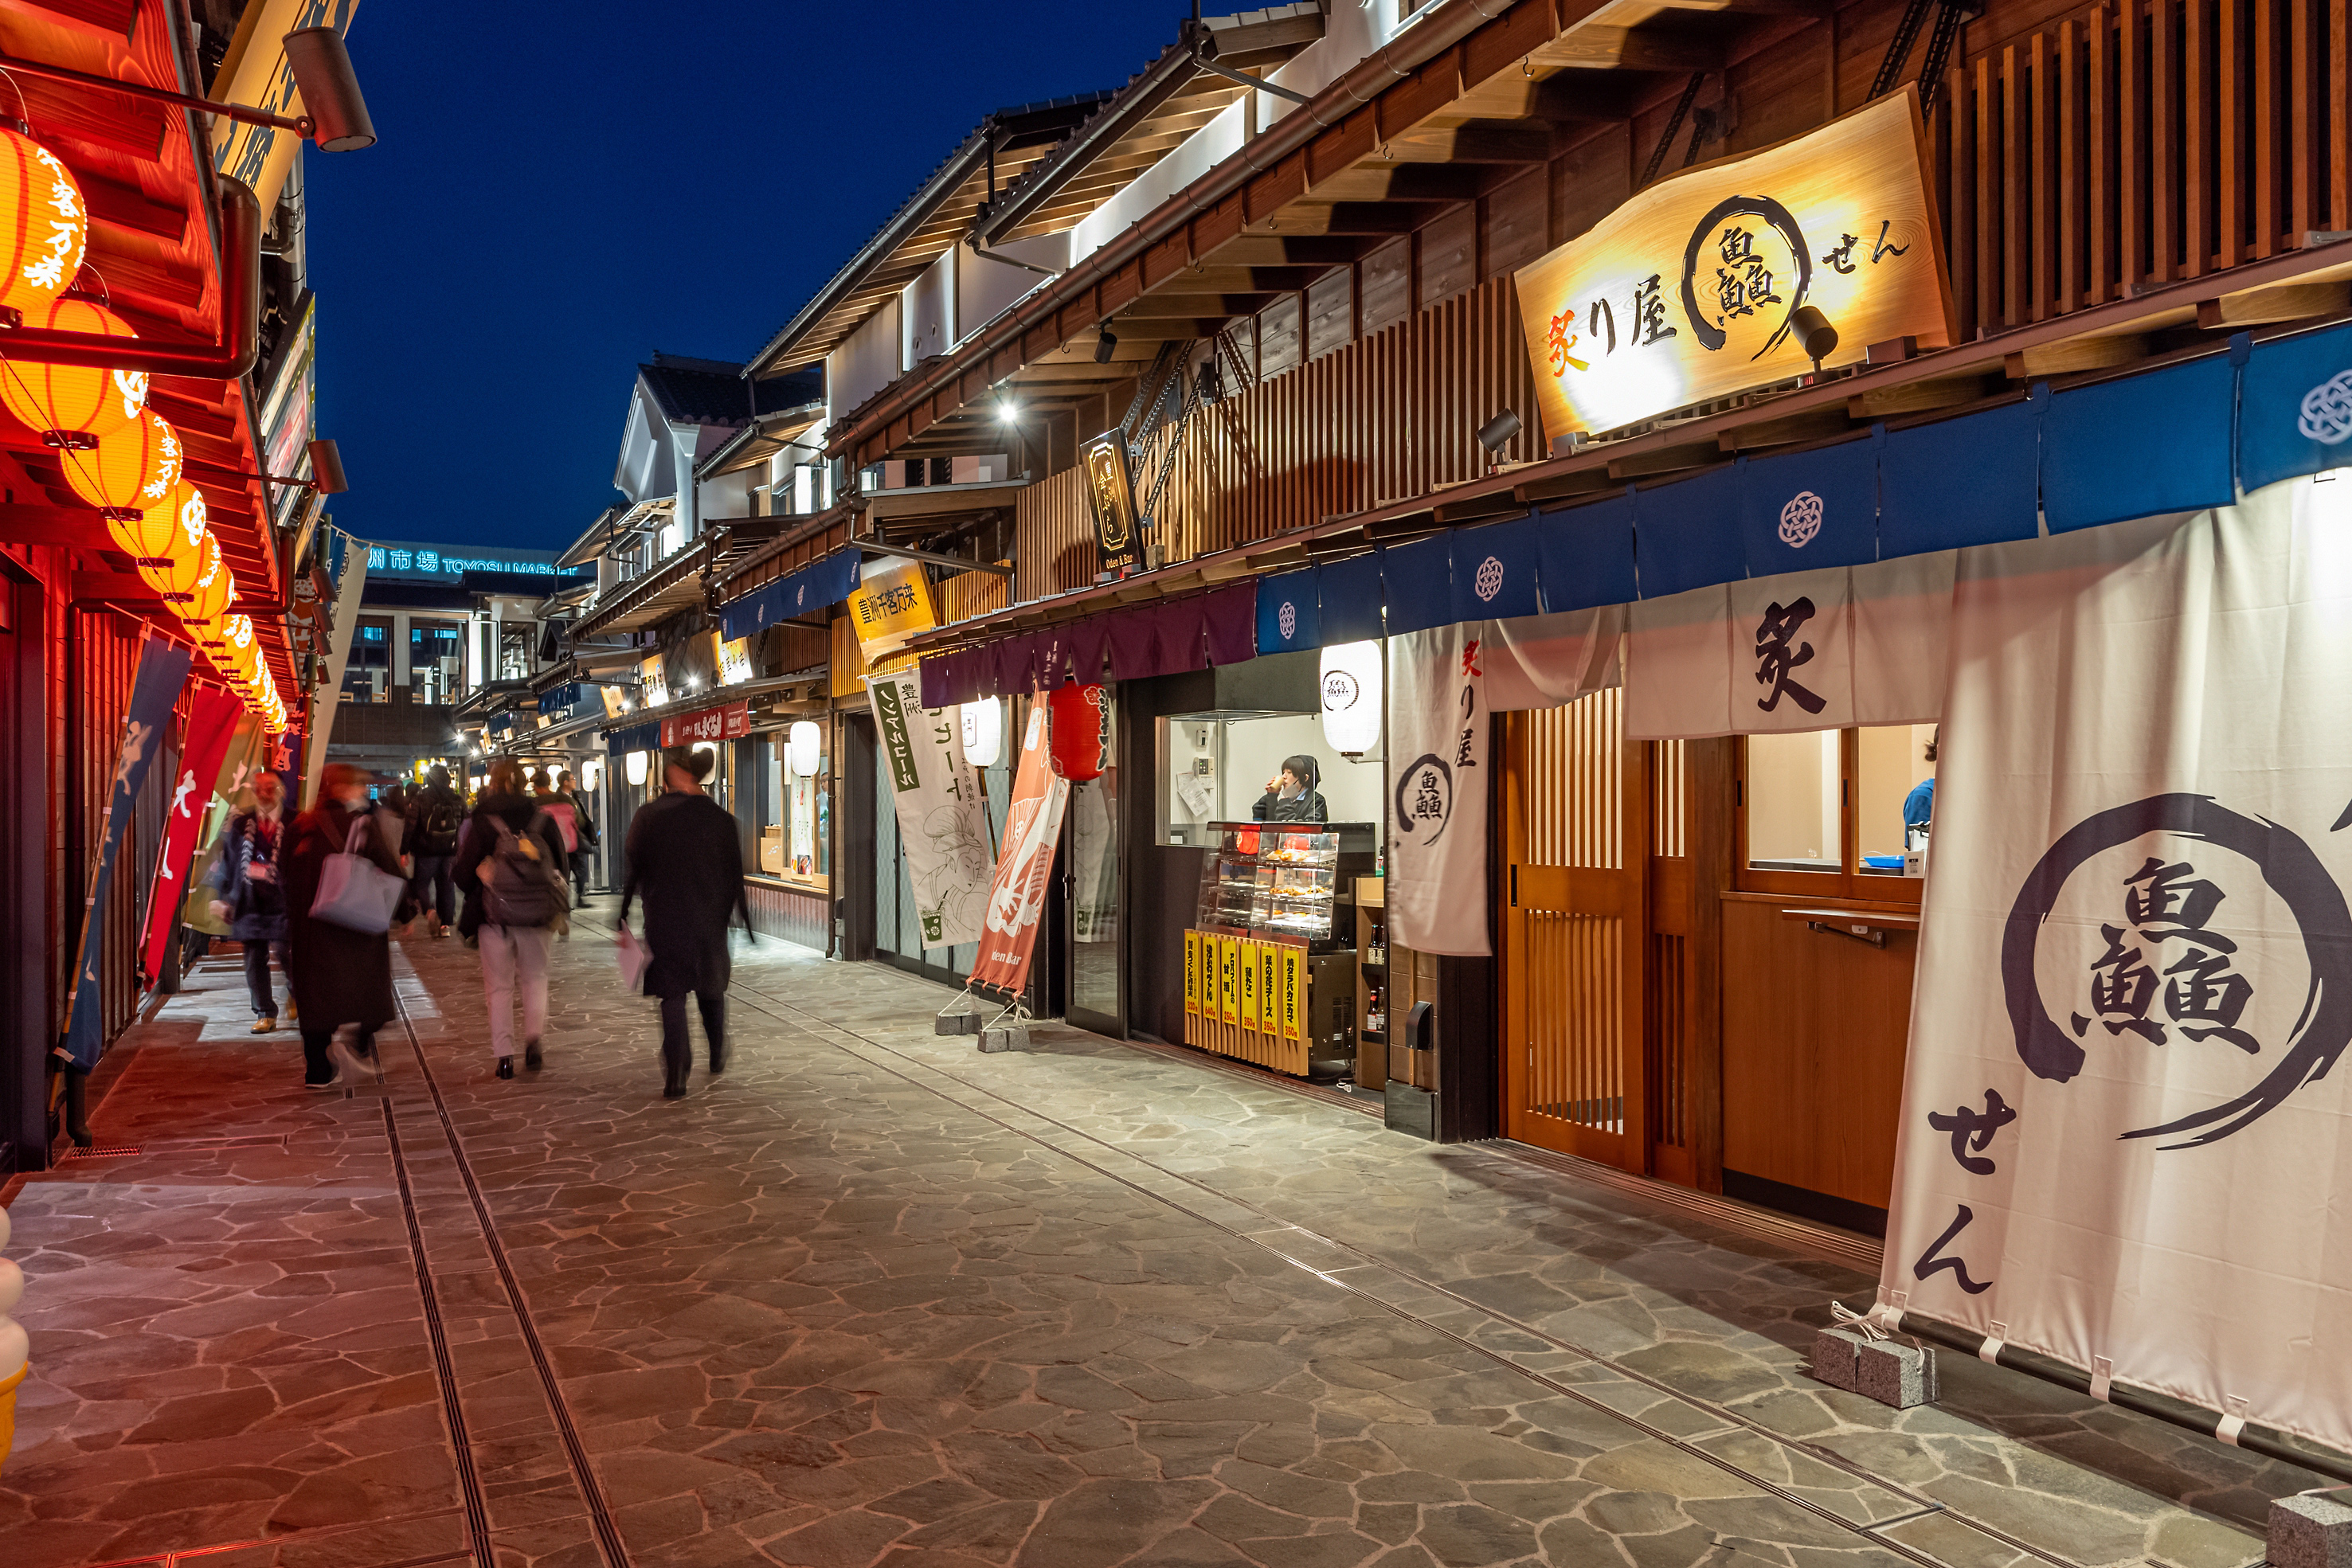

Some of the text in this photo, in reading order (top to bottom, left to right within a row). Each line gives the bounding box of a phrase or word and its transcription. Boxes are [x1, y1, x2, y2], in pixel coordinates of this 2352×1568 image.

[23, 147, 80, 289] 千客万来
[143, 416, 178, 499] 千客万来
[859, 583, 918, 624] 豊洲千客万来
[1106, 557, 1118, 569] Oden
[1123, 554, 1133, 564] Bar
[1454, 639, 1482, 768] 炙り屋
[1755, 596, 1827, 714] 炙
[1913, 1088, 2017, 1295] せん
